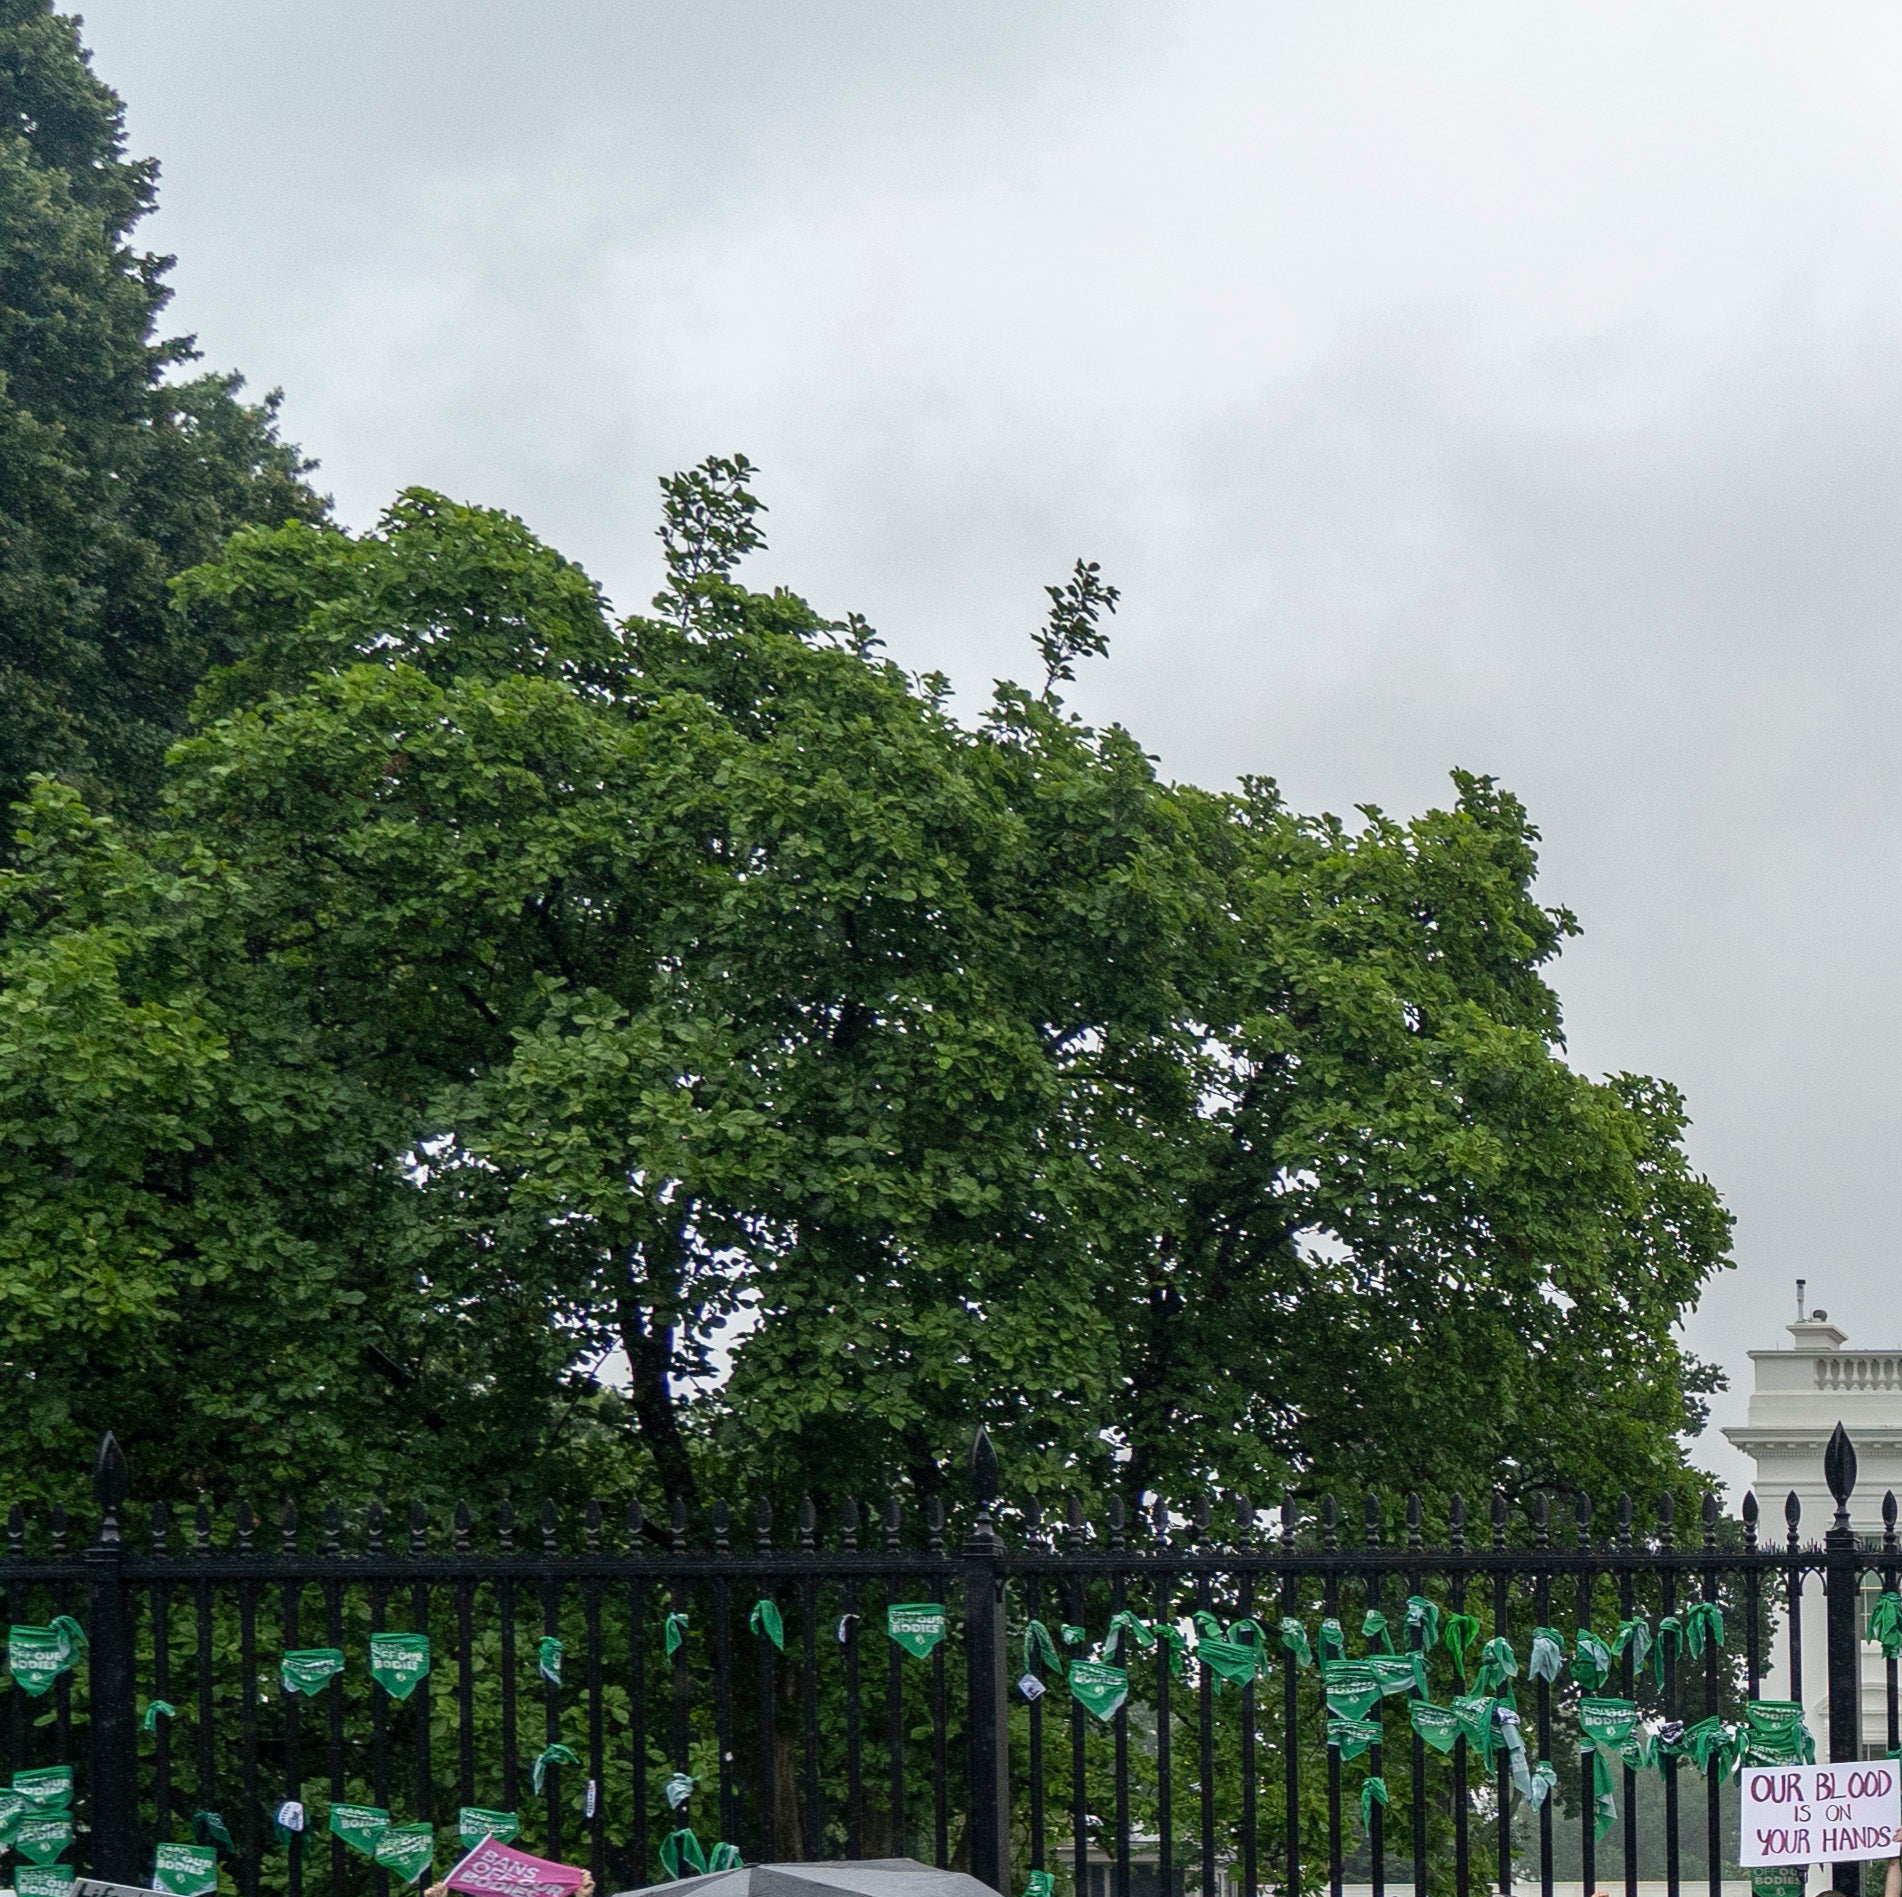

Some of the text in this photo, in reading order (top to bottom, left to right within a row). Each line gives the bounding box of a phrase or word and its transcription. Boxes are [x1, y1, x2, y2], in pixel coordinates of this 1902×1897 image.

[892, 1624, 940, 1633] BODIES
[374, 1660, 418, 1671] BODIES
[1750, 1770, 1893, 1803] OUR BLOOD
[1794, 1804, 1851, 1822] IS ON
[1757, 1826, 1892, 1856] YOUR HANDS
[157, 1860, 206, 1875] BODIES
[472, 1862, 512, 1883] OFF
[481, 1849, 540, 1881] BANS
